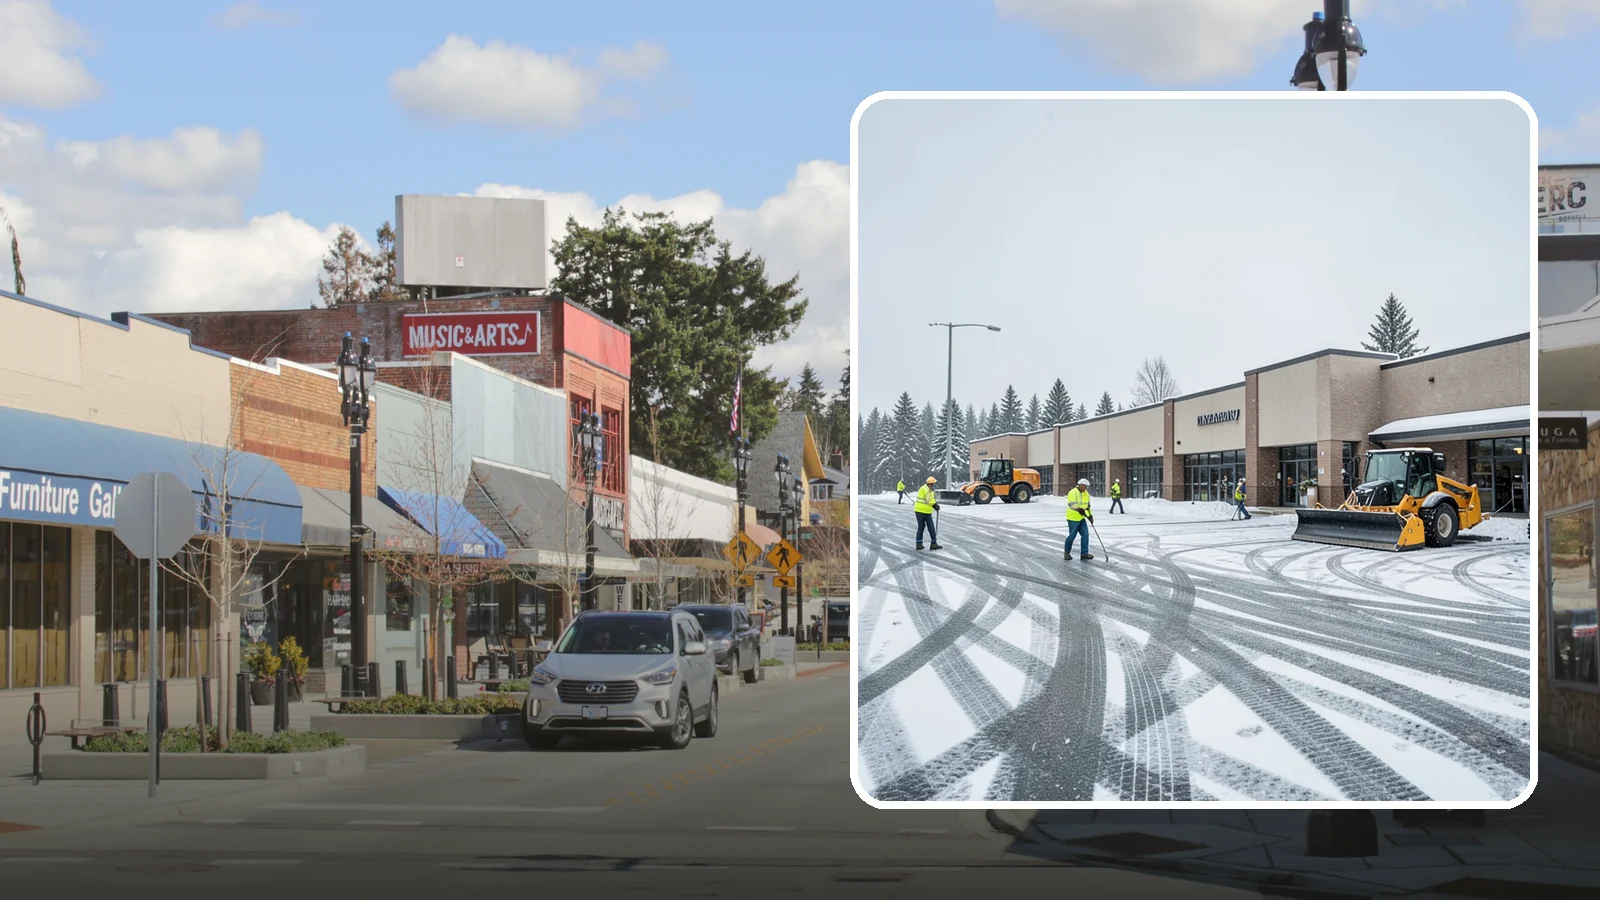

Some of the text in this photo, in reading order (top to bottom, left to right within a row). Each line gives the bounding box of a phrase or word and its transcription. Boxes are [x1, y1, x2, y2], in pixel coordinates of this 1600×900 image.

[409, 323, 519, 349] MUSIC&ARTS
[1540, 427, 1578, 436] UGA
[0, 471, 122, 519] Furniture Gal
